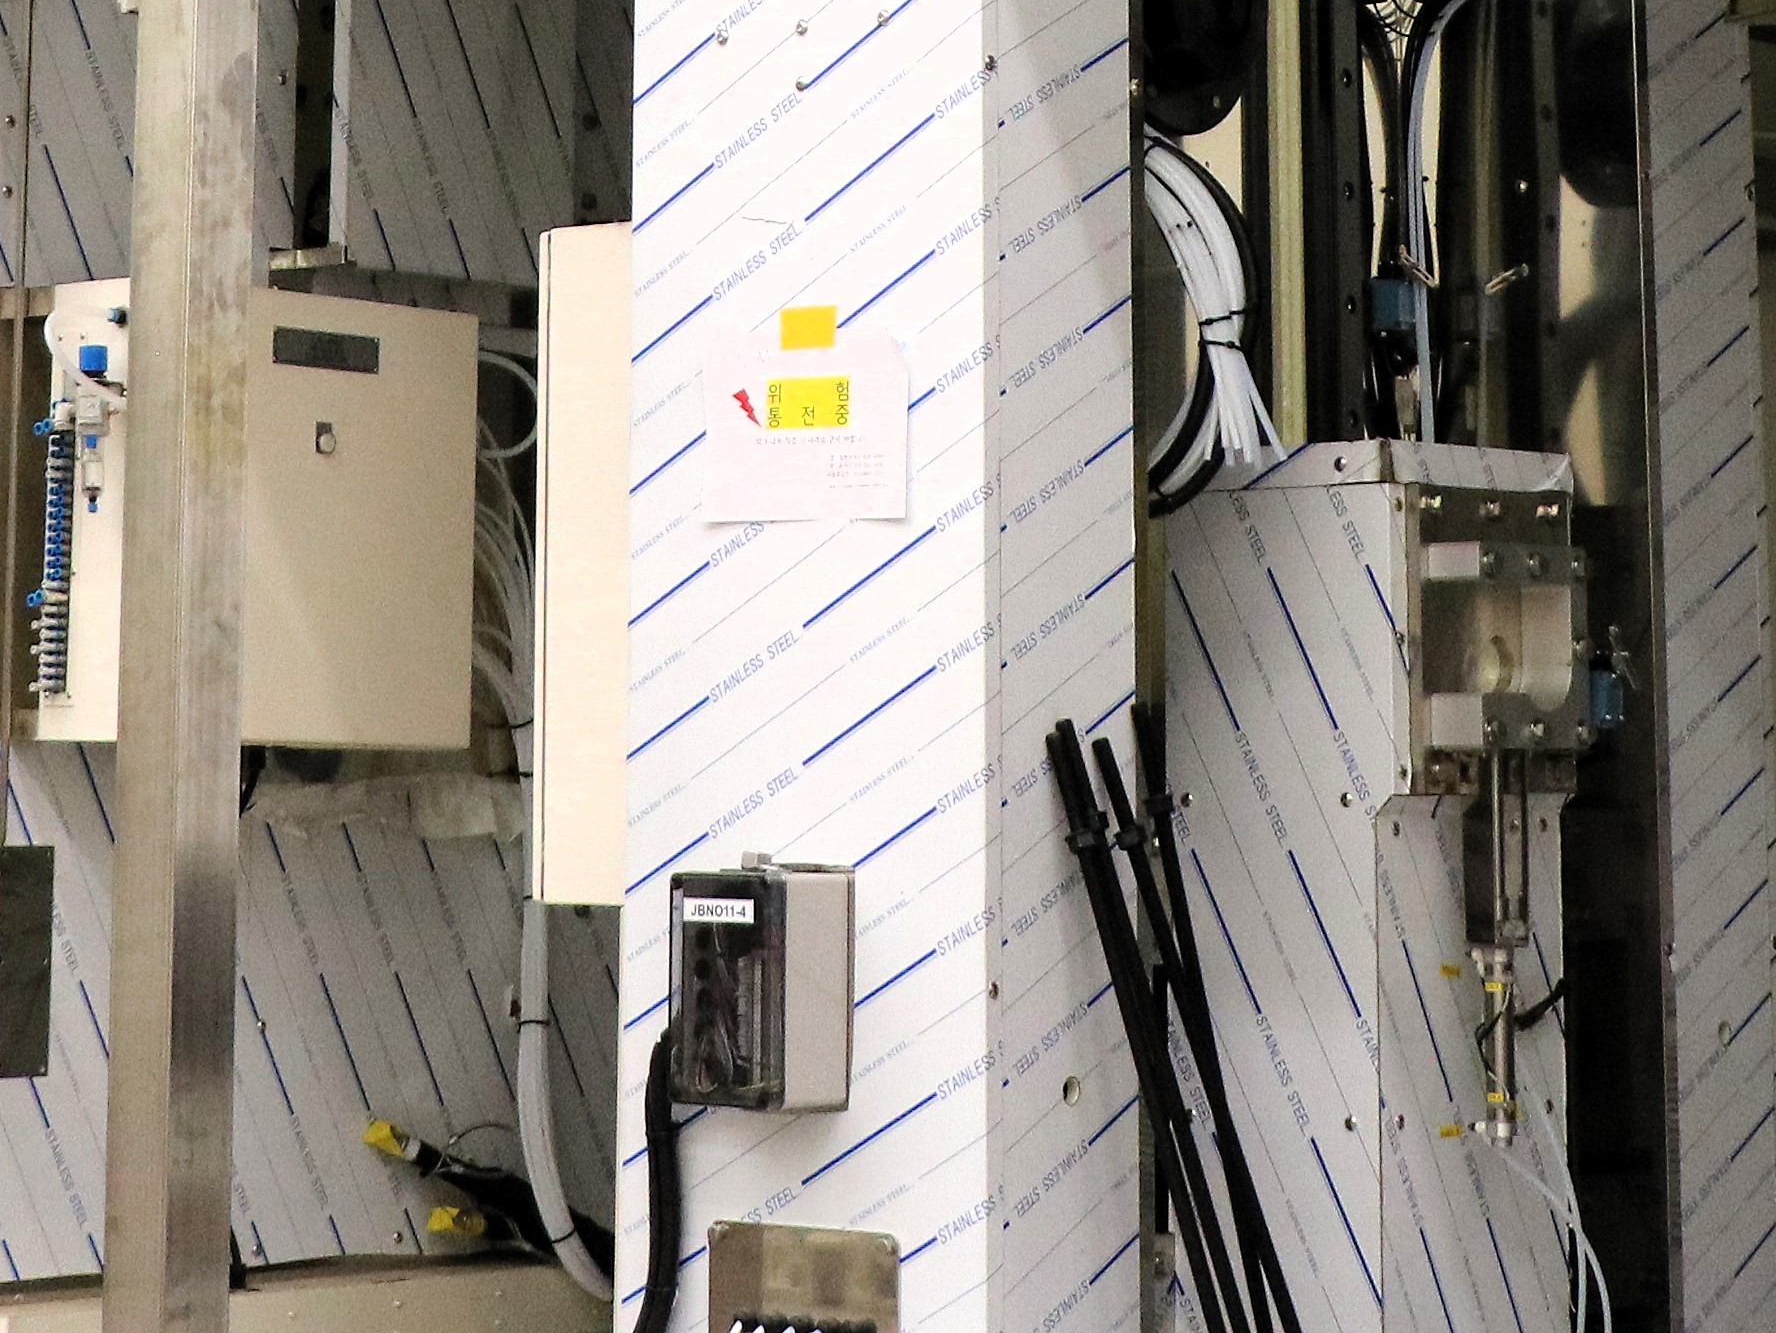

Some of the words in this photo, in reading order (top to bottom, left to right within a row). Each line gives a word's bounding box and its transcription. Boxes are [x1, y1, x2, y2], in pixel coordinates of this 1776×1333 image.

[715, 118, 768, 167] STAINLESS
[771, 90, 802, 121] STEEL
[714, 250, 767, 299] STAINLESS
[770, 222, 802, 253] STEEL
[710, 655, 765, 701] STAINLESS
[768, 628, 800, 658] STEEL
[710, 791, 765, 837] STAINLESS
[767, 765, 800, 795] STEEL
[1235, 732, 1271, 802] STAINLESS
[1265, 804, 1288, 845] STEEL
[1256, 1016, 1292, 1086] STAINLESS
[1287, 1090, 1311, 1129] STEEL
